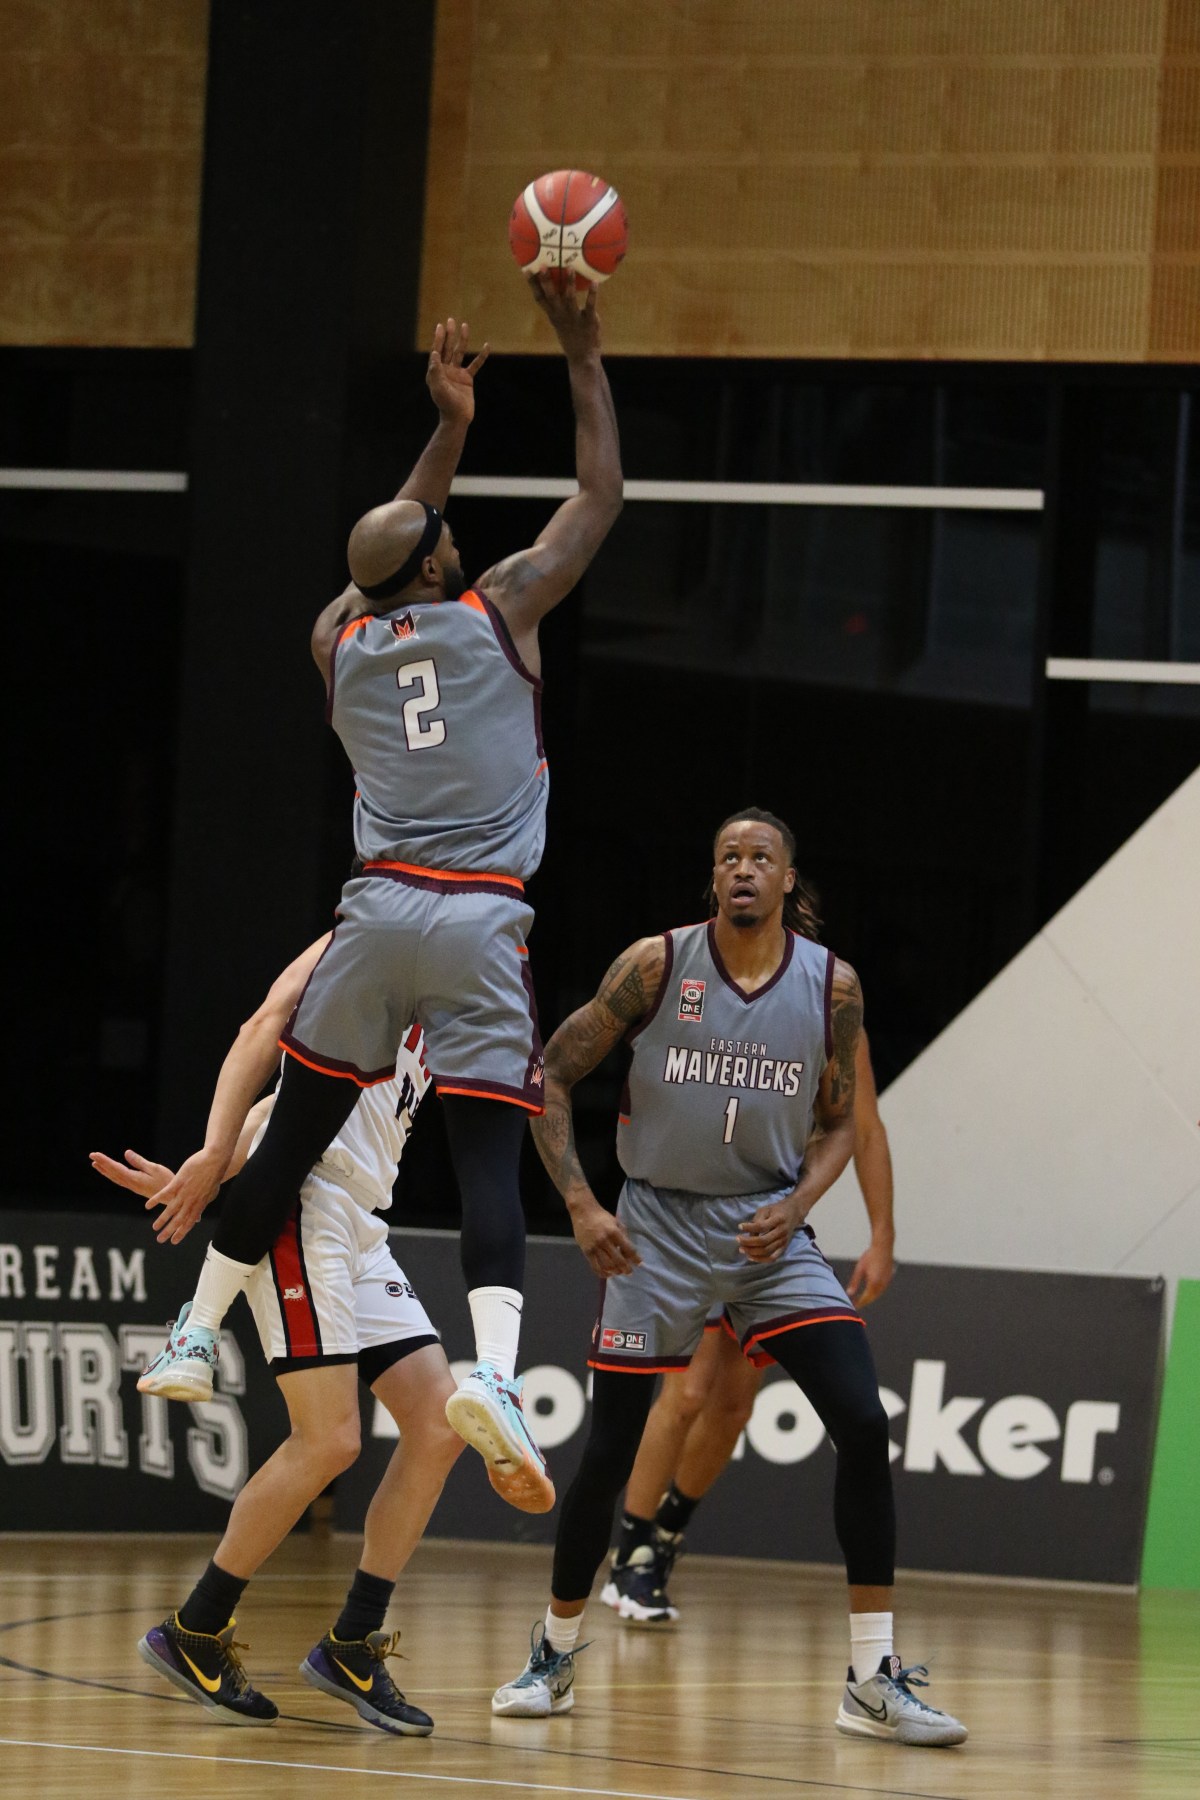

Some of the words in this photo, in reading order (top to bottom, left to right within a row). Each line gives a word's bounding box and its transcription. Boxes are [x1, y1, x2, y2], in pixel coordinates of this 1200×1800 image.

[396, 657, 447, 751] 2
[682, 1003, 700, 1014] ONE
[663, 1045, 804, 1097] MAVERICKS
[710, 1037, 768, 1057] EASTERN
[723, 1096, 740, 1145] 1
[0, 1243, 148, 1302] REAM
[626, 1334, 645, 1344] ONE
[731, 1359, 1120, 1484] oker
